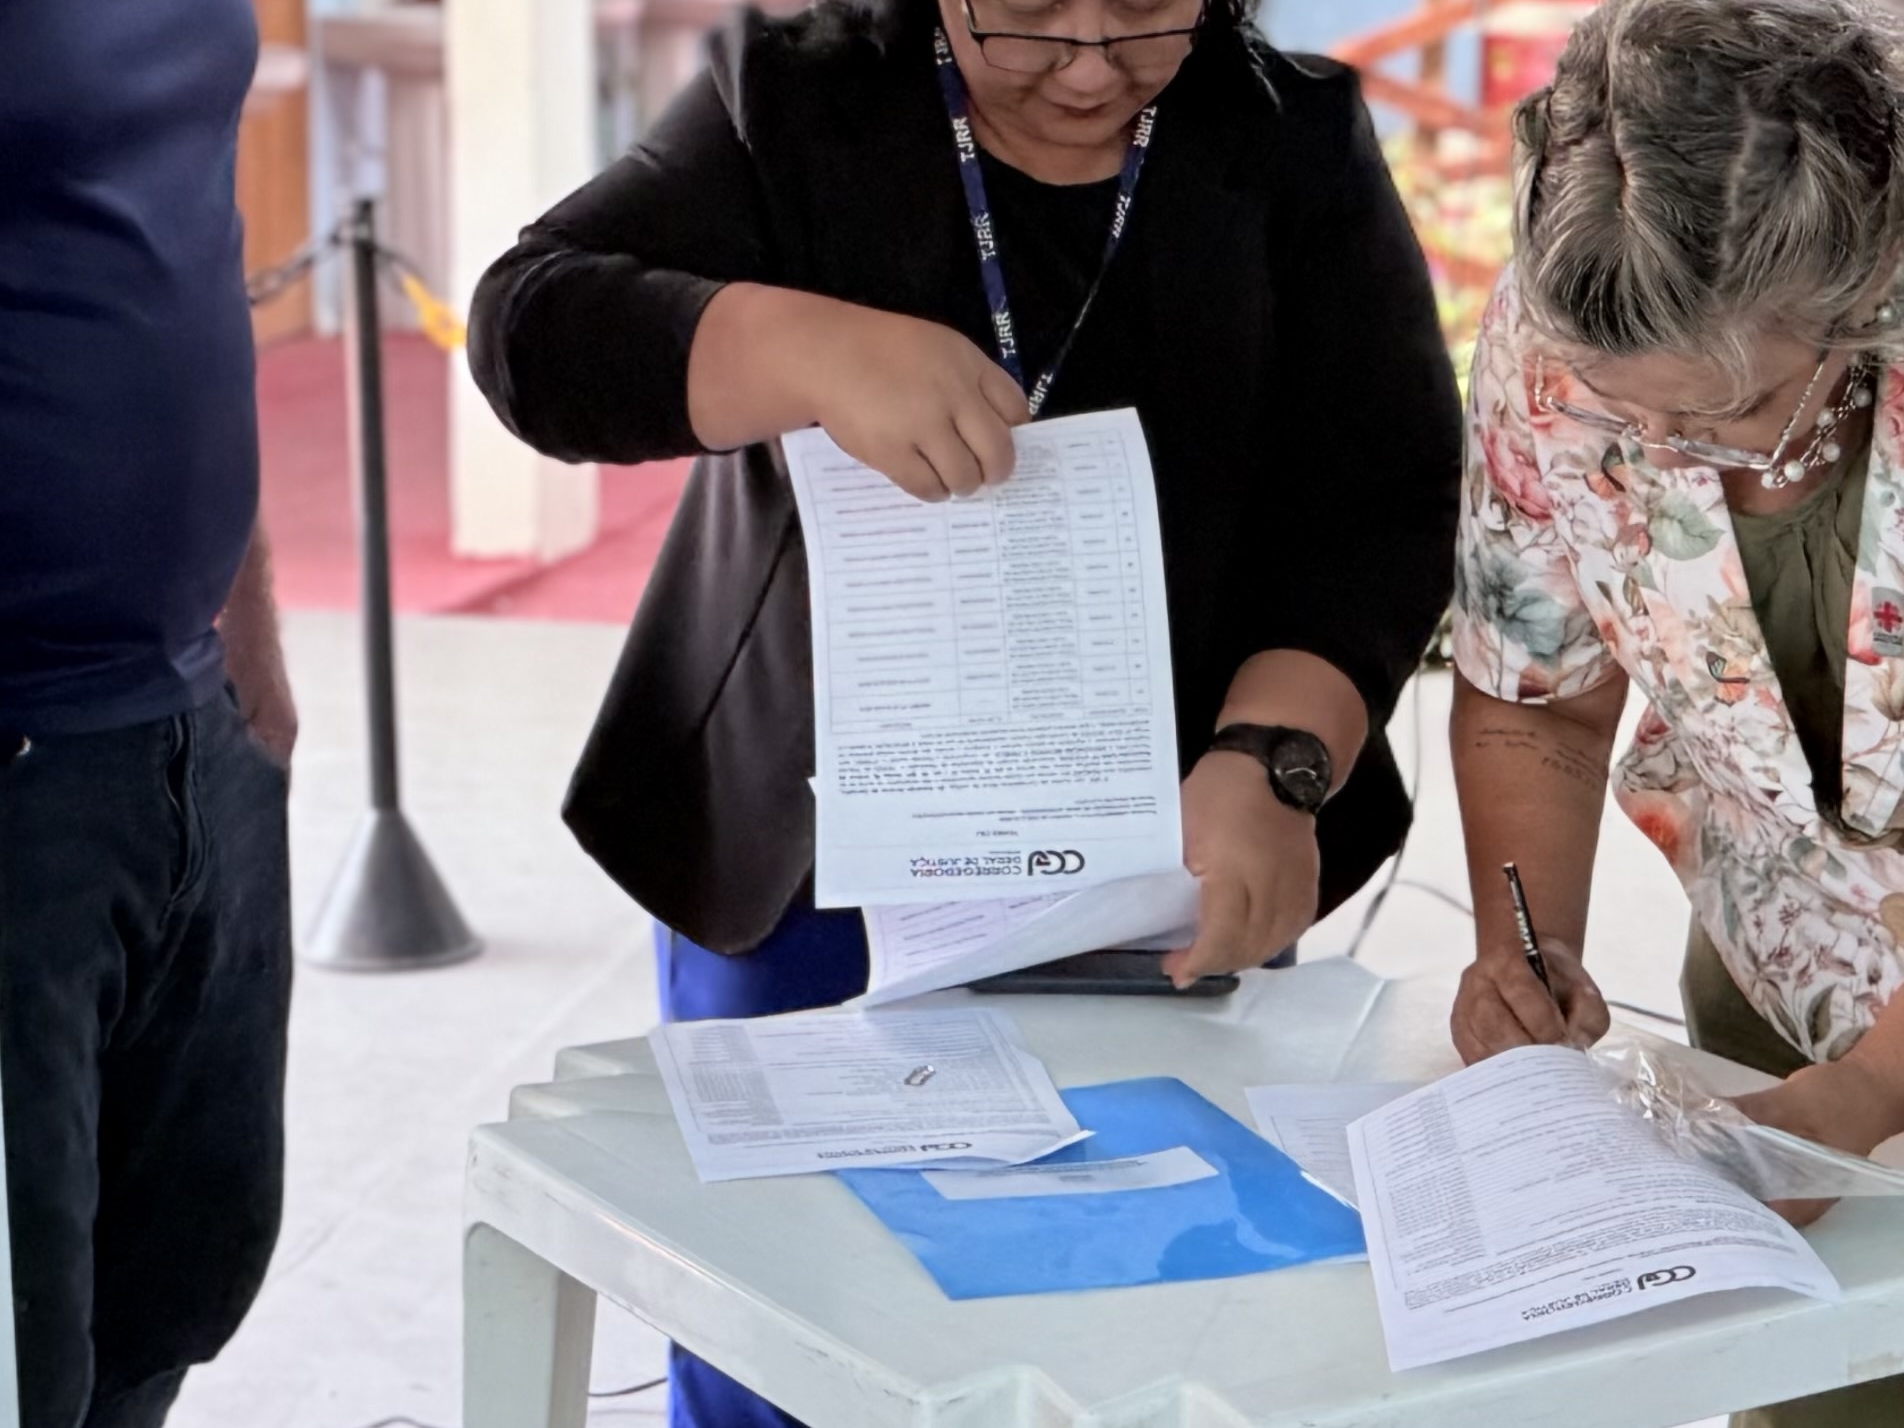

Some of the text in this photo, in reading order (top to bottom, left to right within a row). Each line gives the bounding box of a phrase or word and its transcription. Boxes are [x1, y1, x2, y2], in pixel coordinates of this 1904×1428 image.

[953, 116, 975, 163] TJRR
[1133, 106, 1157, 147] TJRR
[973, 211, 996, 261] TJRR
[994, 310, 1017, 360] TJRR
[1027, 849, 1086, 876] CGJ
[1636, 1265, 1697, 1290] CGJ
